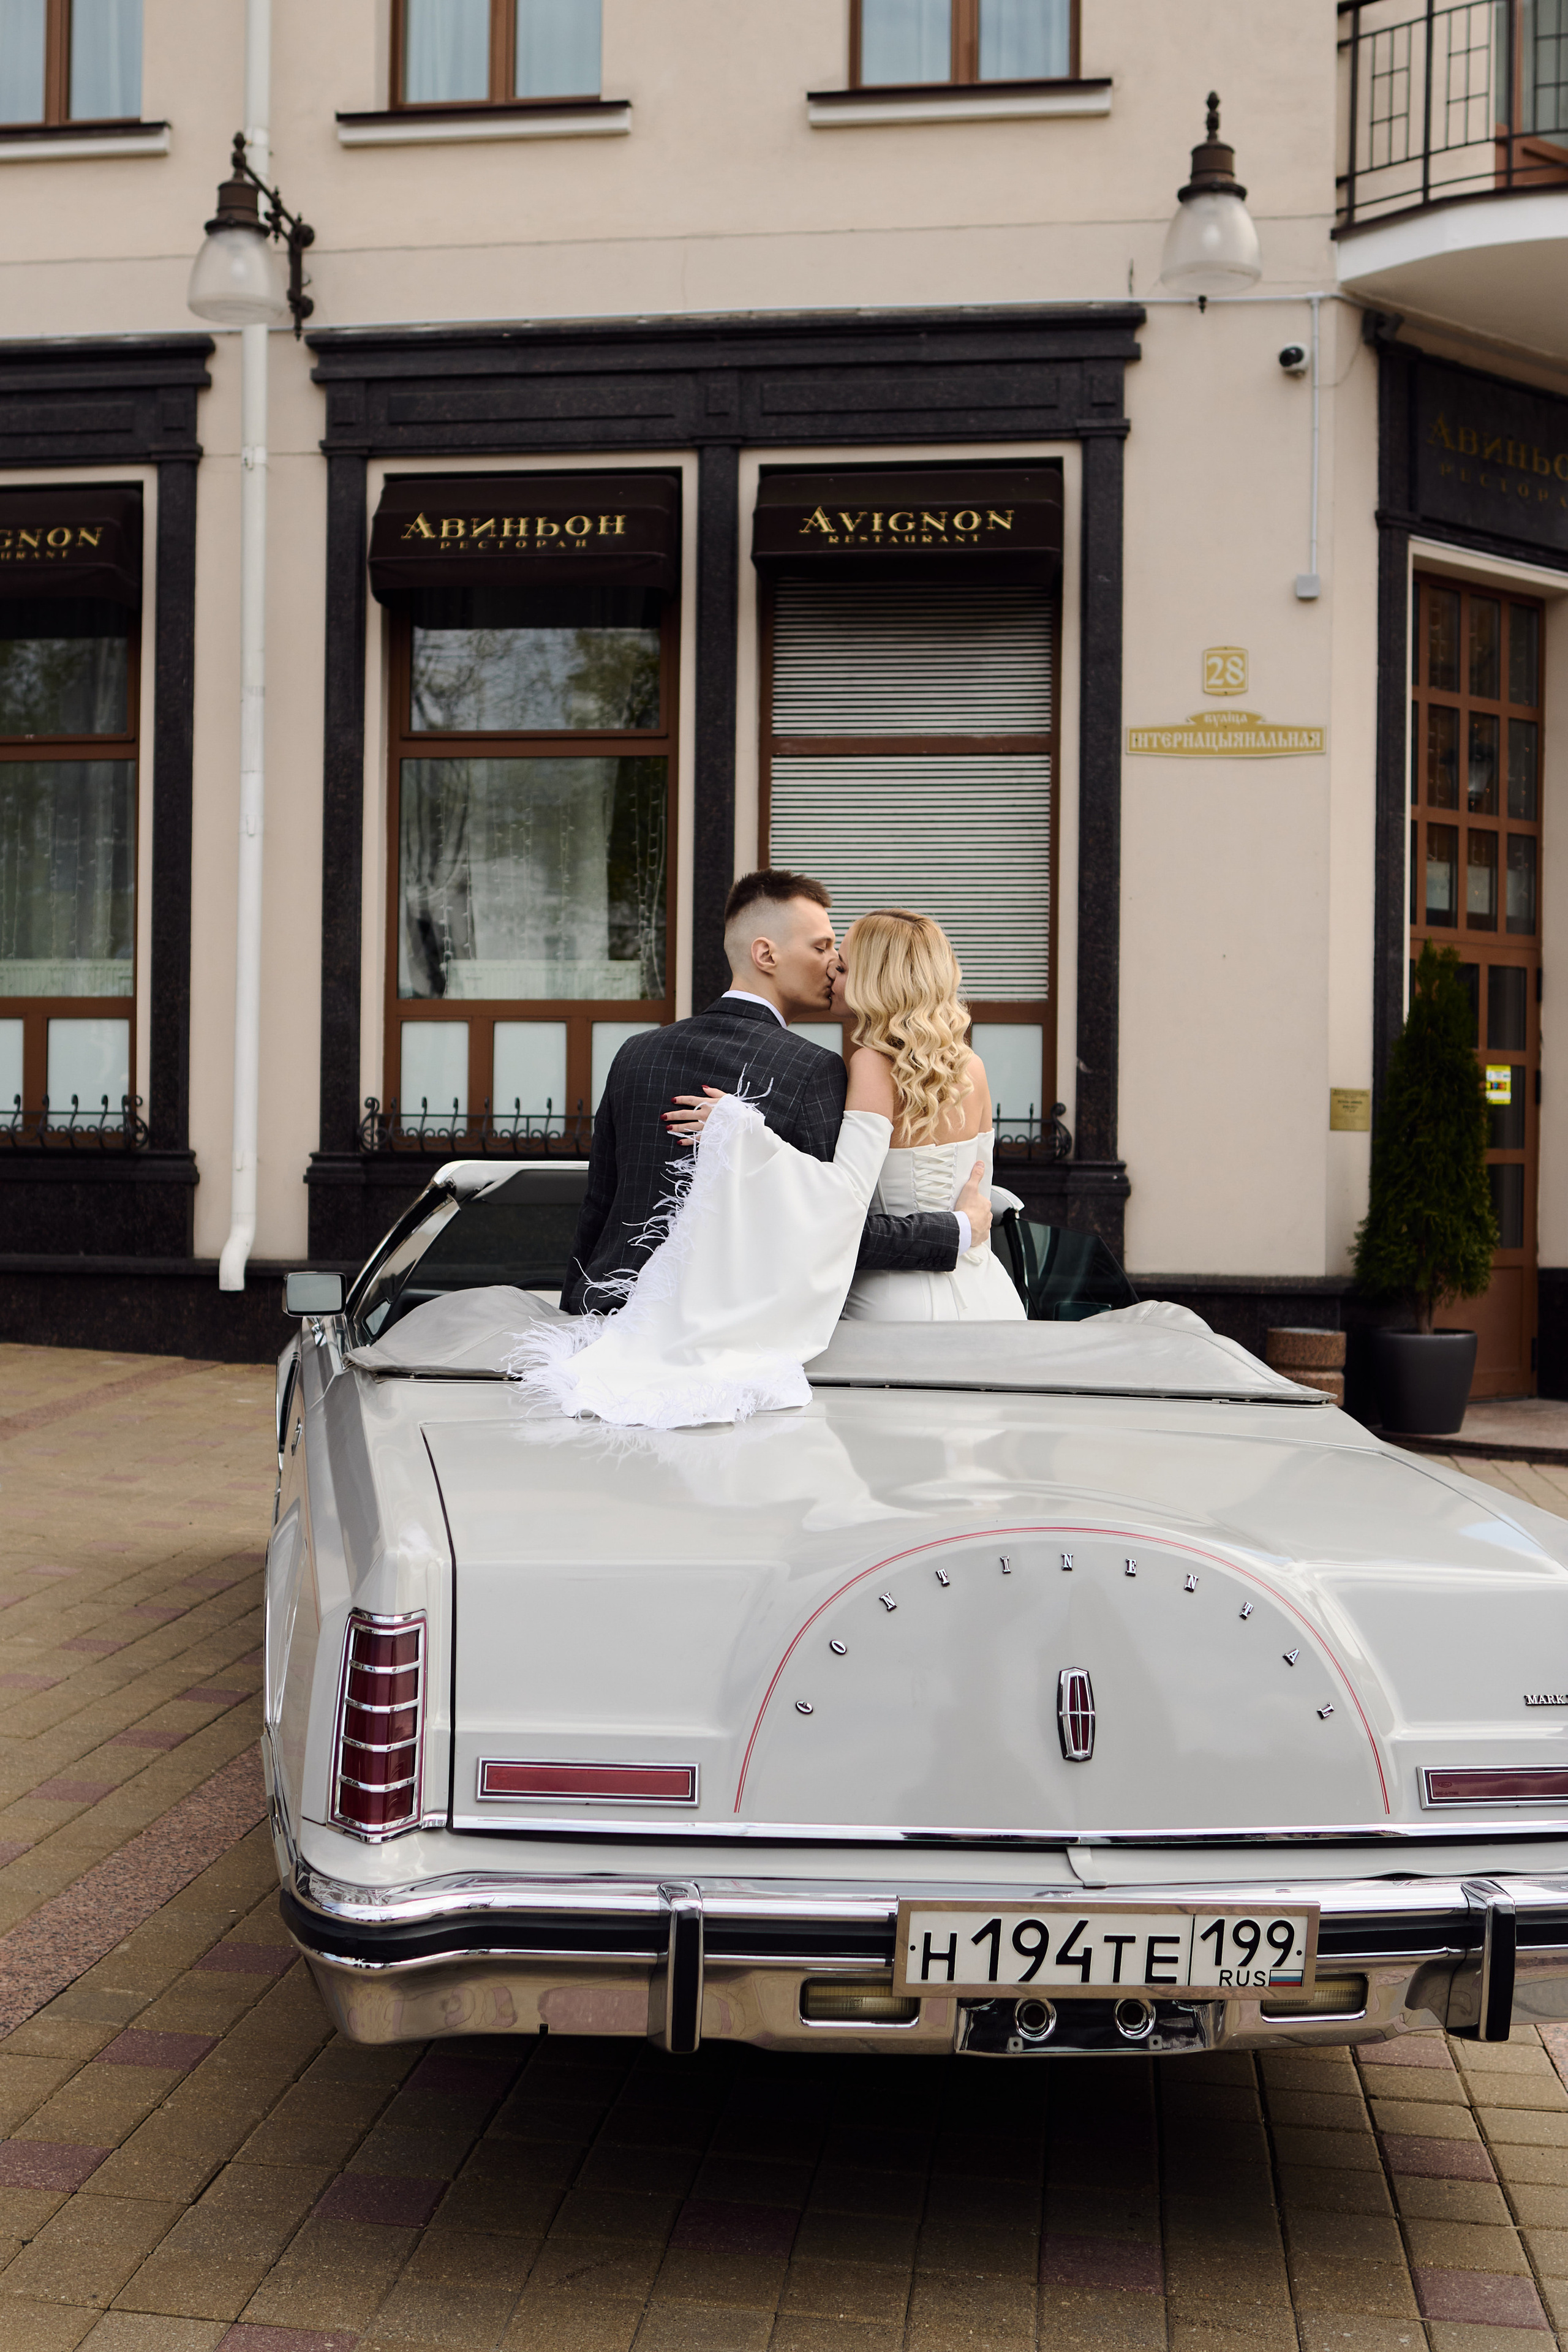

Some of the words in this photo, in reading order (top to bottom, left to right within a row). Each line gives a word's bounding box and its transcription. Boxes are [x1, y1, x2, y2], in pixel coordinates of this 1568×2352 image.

[401, 512, 627, 540] АВИНЬОН
[799, 505, 1015, 533] AVIGNON
[440, 539, 587, 549] РЕСТОРАН
[827, 534, 981, 544] RESTAURANT
[1207, 655, 1245, 686] 28
[795, 1552, 1335, 1720] CONTINENTAL
[1524, 1694, 1566, 1706] MARK
[1199, 1918, 1295, 1967] 199
[1218, 1969, 1267, 1987] RUS
